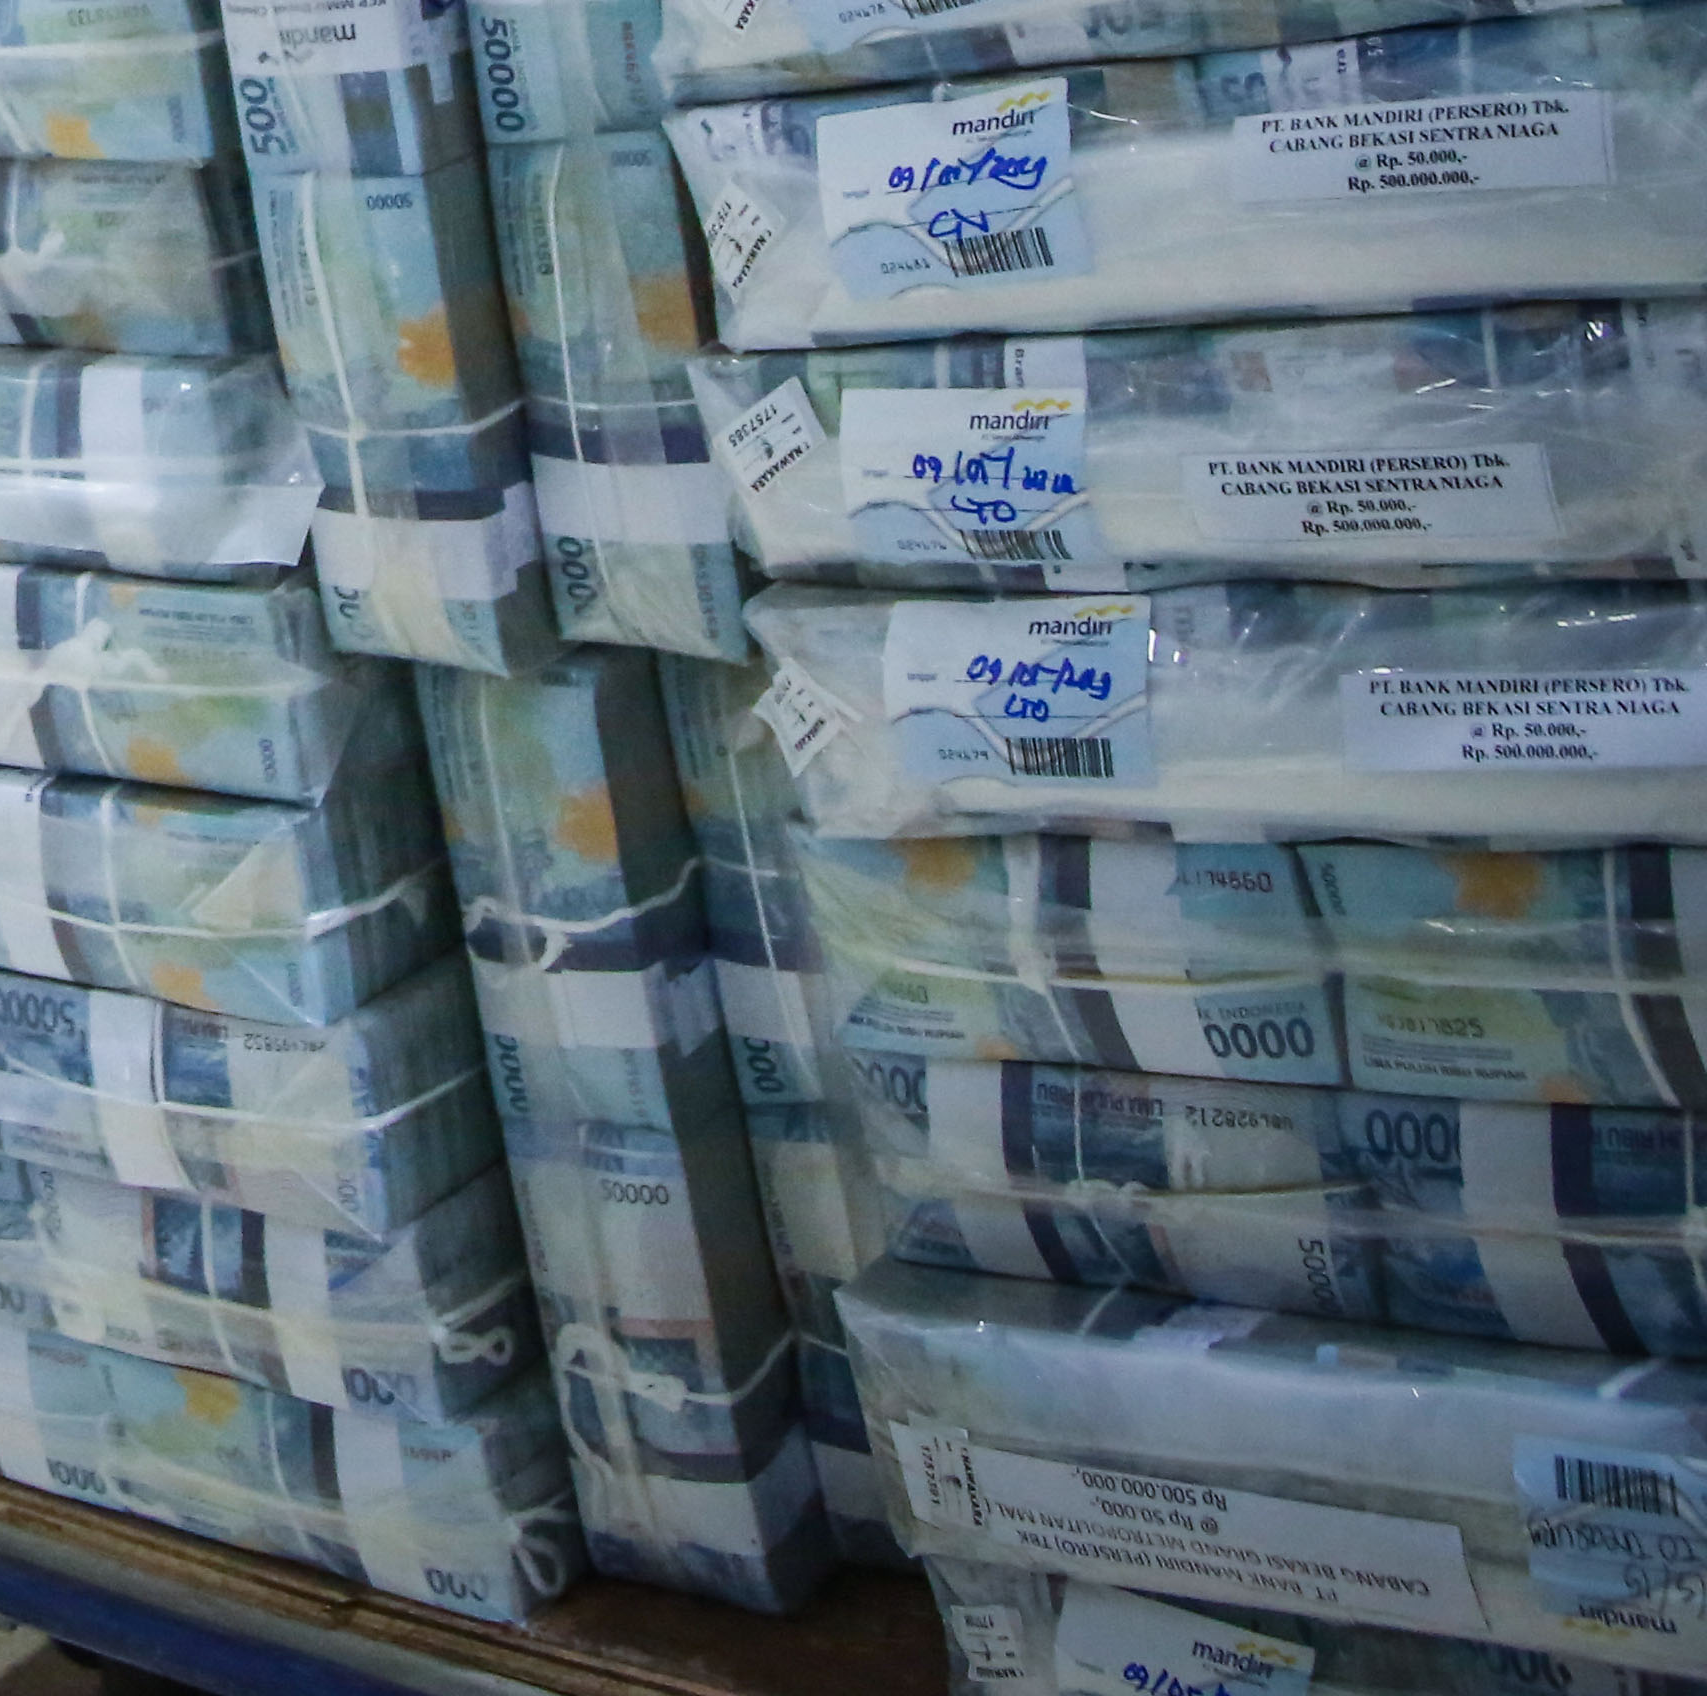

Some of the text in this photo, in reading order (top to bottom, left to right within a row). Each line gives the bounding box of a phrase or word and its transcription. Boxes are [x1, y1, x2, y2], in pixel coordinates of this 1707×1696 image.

[479, 15, 527, 134] 50000
[952, 107, 1037, 137] mandiri
[1289, 112, 1339, 134] BANK
[1342, 106, 1425, 128] MANDIRI
[1427, 100, 1529, 126] (PERSERO)
[1530, 98, 1570, 117] Tbk.
[1267, 120, 1560, 155] CABANG BEKASI SENTRA NIAGA
[1375, 153, 1404, 172] Rp.
[1406, 148, 1470, 169] 50.000,-
[1346, 174, 1377, 194] Rp.
[968, 409, 1051, 432] mandiri
[1236, 456, 1286, 476] BANK
[1287, 454, 1367, 474] MANDIRI
[1369, 453, 1470, 475] (PERSERO)
[1471, 452, 1511, 469] Tbk.
[1220, 473, 1505, 497] CABANG BEKASI SENTRA NIAGA
[1325, 499, 1354, 518] Rp.
[1357, 498, 1418, 515] 50.000,-
[1301, 518, 1331, 536] Rp.
[1027, 615, 1113, 639] mandiri
[1399, 679, 1451, 695] BANK
[1454, 678, 1540, 695] MANDIRI
[1543, 676, 1649, 697] (PERSERO)
[1379, 700, 1682, 718] CABANG BEKASI SENTRA NIAGA
[1490, 722, 1520, 740] Rp.
[1523, 721, 1588, 739] 50.000,-
[1460, 743, 1490, 764] Rp.
[1197, 1488, 1229, 1512] Rp
[1166, 1511, 1195, 1531] Rp
[1032, 1508, 1433, 1597] CABANG BEKASI GRAND METROPOLITAN
[1053, 1536, 1155, 1570] (PERSERO)
[1155, 1552, 1249, 1586] MANDIRI
[1252, 1571, 1309, 1598] BANK
[1190, 1639, 1274, 1680] mandiri
